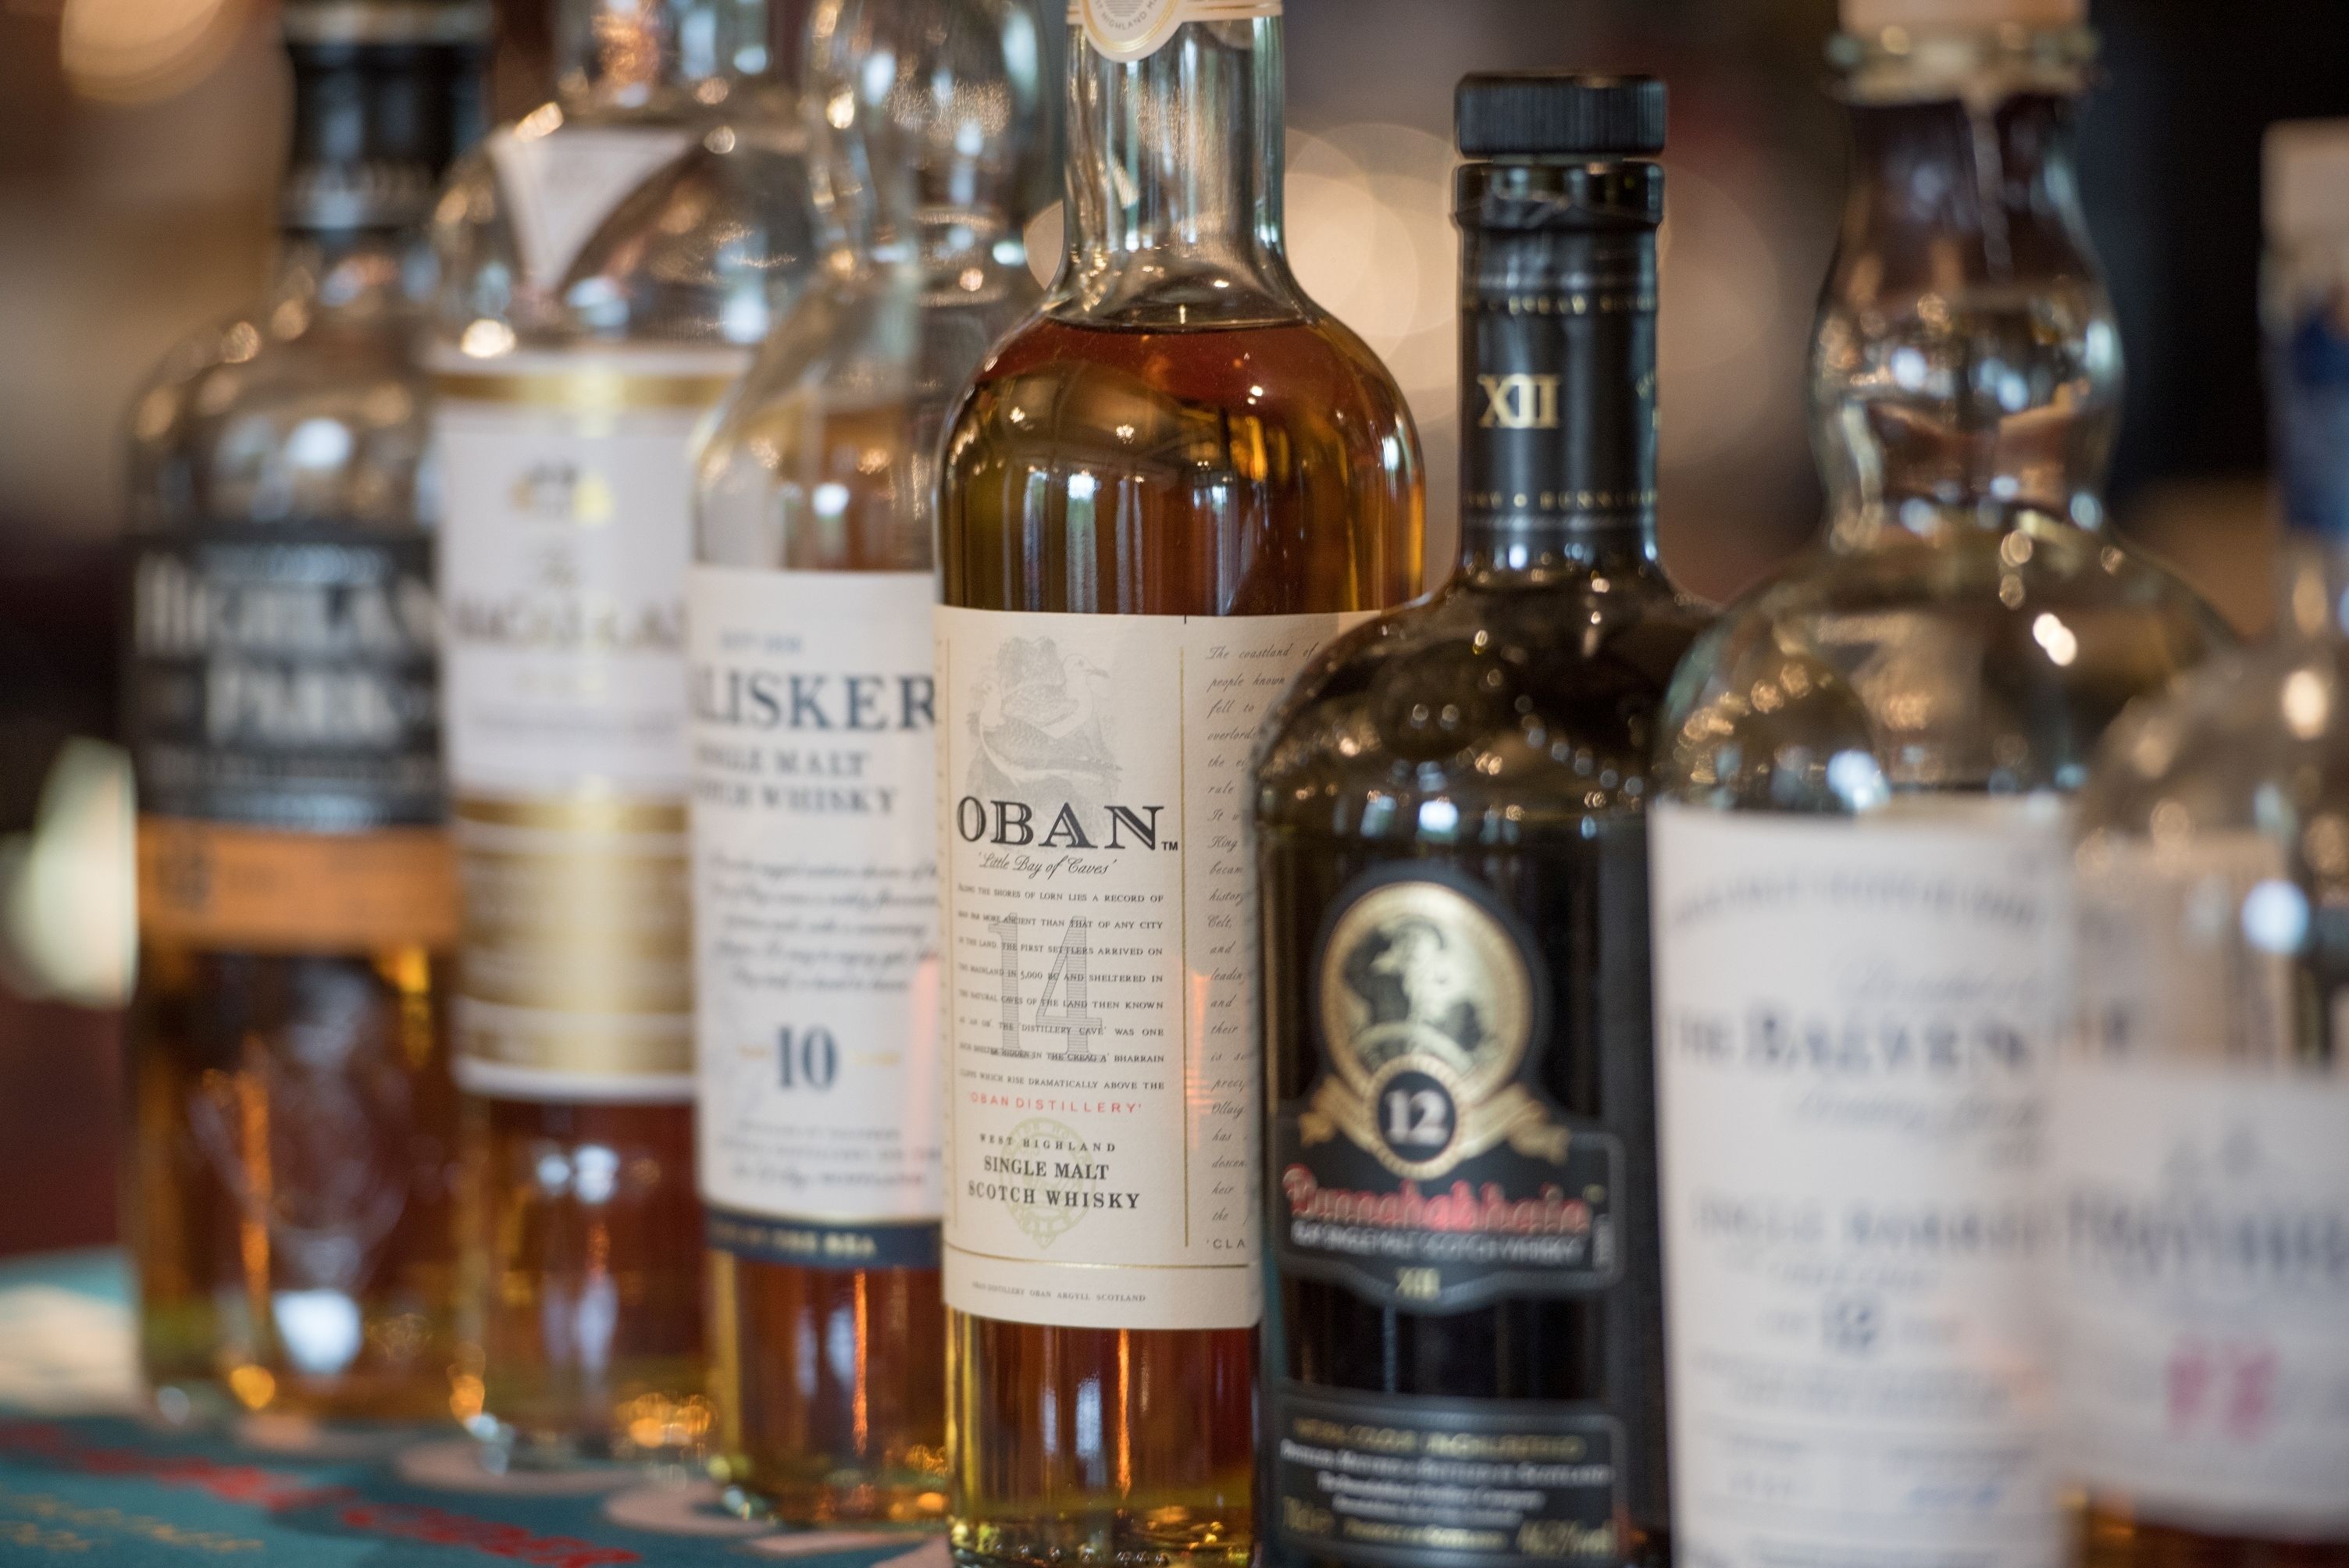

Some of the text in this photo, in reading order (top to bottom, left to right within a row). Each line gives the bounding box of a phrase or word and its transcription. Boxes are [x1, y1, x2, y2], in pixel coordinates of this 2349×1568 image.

[1101, 11, 1147, 30] HIGHLAND
[1477, 372, 1559, 429] XII
[1206, 642, 1319, 660] The coastland of
[1207, 672, 1286, 693] people known
[1207, 700, 1255, 718] fell to
[1207, 754, 1224, 767] the
[1207, 781, 1235, 793] rule
[957, 796, 1164, 851] OBAN
[1207, 836, 1238, 853] King
[1012, 855, 1043, 879] Bay
[1045, 855, 1068, 880] of
[1210, 861, 1244, 875] becam
[993, 888, 1021, 899] SHORES
[1025, 891, 1036, 900] OF
[1039, 892, 1063, 901] LORN
[1104, 894, 1145, 903] RECORD
[1150, 894, 1164, 903] OF
[1003, 914, 1036, 926] ANCIENT
[1041, 918, 1065, 927] THAN
[1069, 919, 1093, 928] THAT
[1114, 921, 1134, 929] ANY
[1139, 921, 1164, 929] CITY
[1001, 942, 1018, 951] THE
[1021, 944, 1043, 953] FIRST
[1047, 946, 1094, 956] SETTLERS
[1097, 947, 1144, 956] ARRIVED
[1210, 940, 1236, 954] and
[1064, 973, 1085, 982] AND
[1089, 974, 1146, 983] SHELTERED
[1041, 999, 1059, 1007] THE
[1063, 1000, 1088, 1008] LAND
[1092, 1000, 1120, 1009] THEN
[1125, 1001, 1164, 1010] KNOWN
[1210, 993, 1237, 1007] and
[999, 1021, 1014, 1031] THE
[1114, 1028, 1135, 1036] WAS
[1141, 1028, 1164, 1036] ONE
[1211, 1021, 1239, 1034] their
[774, 1024, 840, 1091] 10
[1046, 1052, 1064, 1061] THE
[1114, 1054, 1164, 1063] BHARRAIN
[980, 1071, 1003, 1082] WHICH
[1007, 1075, 1025, 1085] RISE
[1028, 1078, 1098, 1089] DRAMATICALLY
[1103, 1081, 1138, 1089] ABOVE
[1143, 1082, 1165, 1090] THE
[1385, 1088, 1451, 1147] 12
[1212, 1128, 1232, 1141] has
[979, 1133, 1116, 1153] WEST HIGHLAND
[983, 1154, 1110, 1181] SINGLE MALT
[1212, 1155, 1247, 1168] descen
[968, 1180, 1141, 1210] SCOTCH WHISKY
[1212, 1181, 1234, 1194] heir
[1212, 1206, 1228, 1220] the
[1029, 1289, 1052, 1299] OBAN
[1057, 1291, 1092, 1301] ARGYLL
[1096, 1293, 1146, 1303] SCOTLAND
